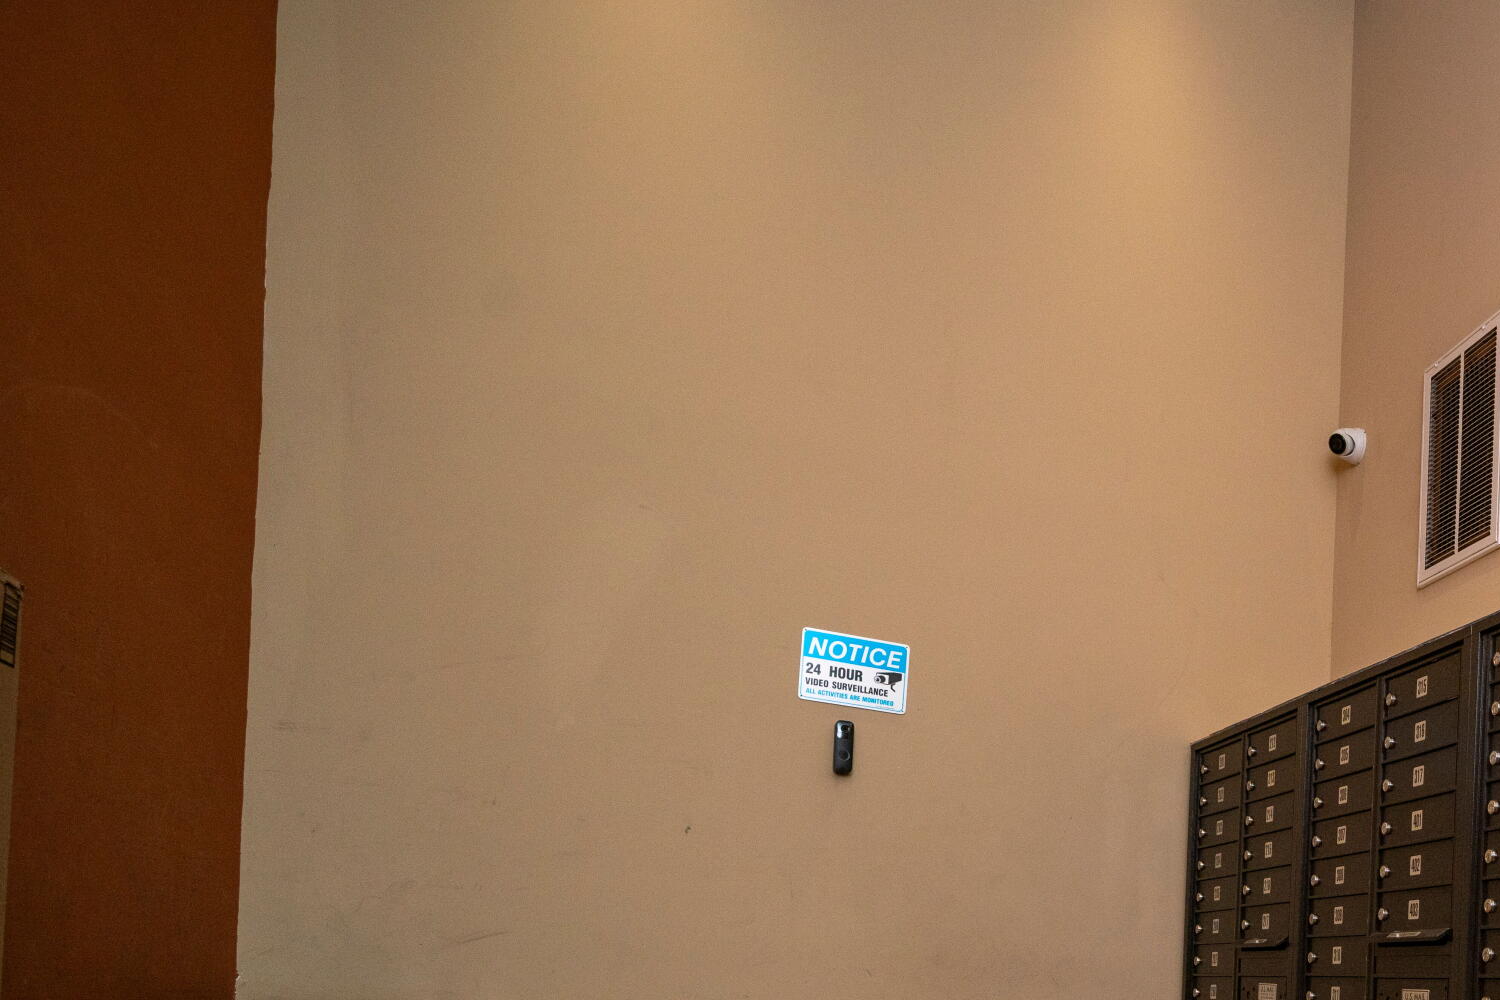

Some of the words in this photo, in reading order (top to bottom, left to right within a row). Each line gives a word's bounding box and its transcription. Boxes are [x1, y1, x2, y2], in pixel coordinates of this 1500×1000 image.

[808, 637, 902, 668] NOTICE
[806, 662, 821, 675] 24
[829, 666, 862, 682] HOUR
[806, 677, 828, 688] VIDEO
[832, 682, 888, 697] SURVEILLANCE
[818, 690, 848, 699] ACTIVITIES
[862, 696, 894, 706] MONITORED
[1413, 767, 1424, 784] 317
